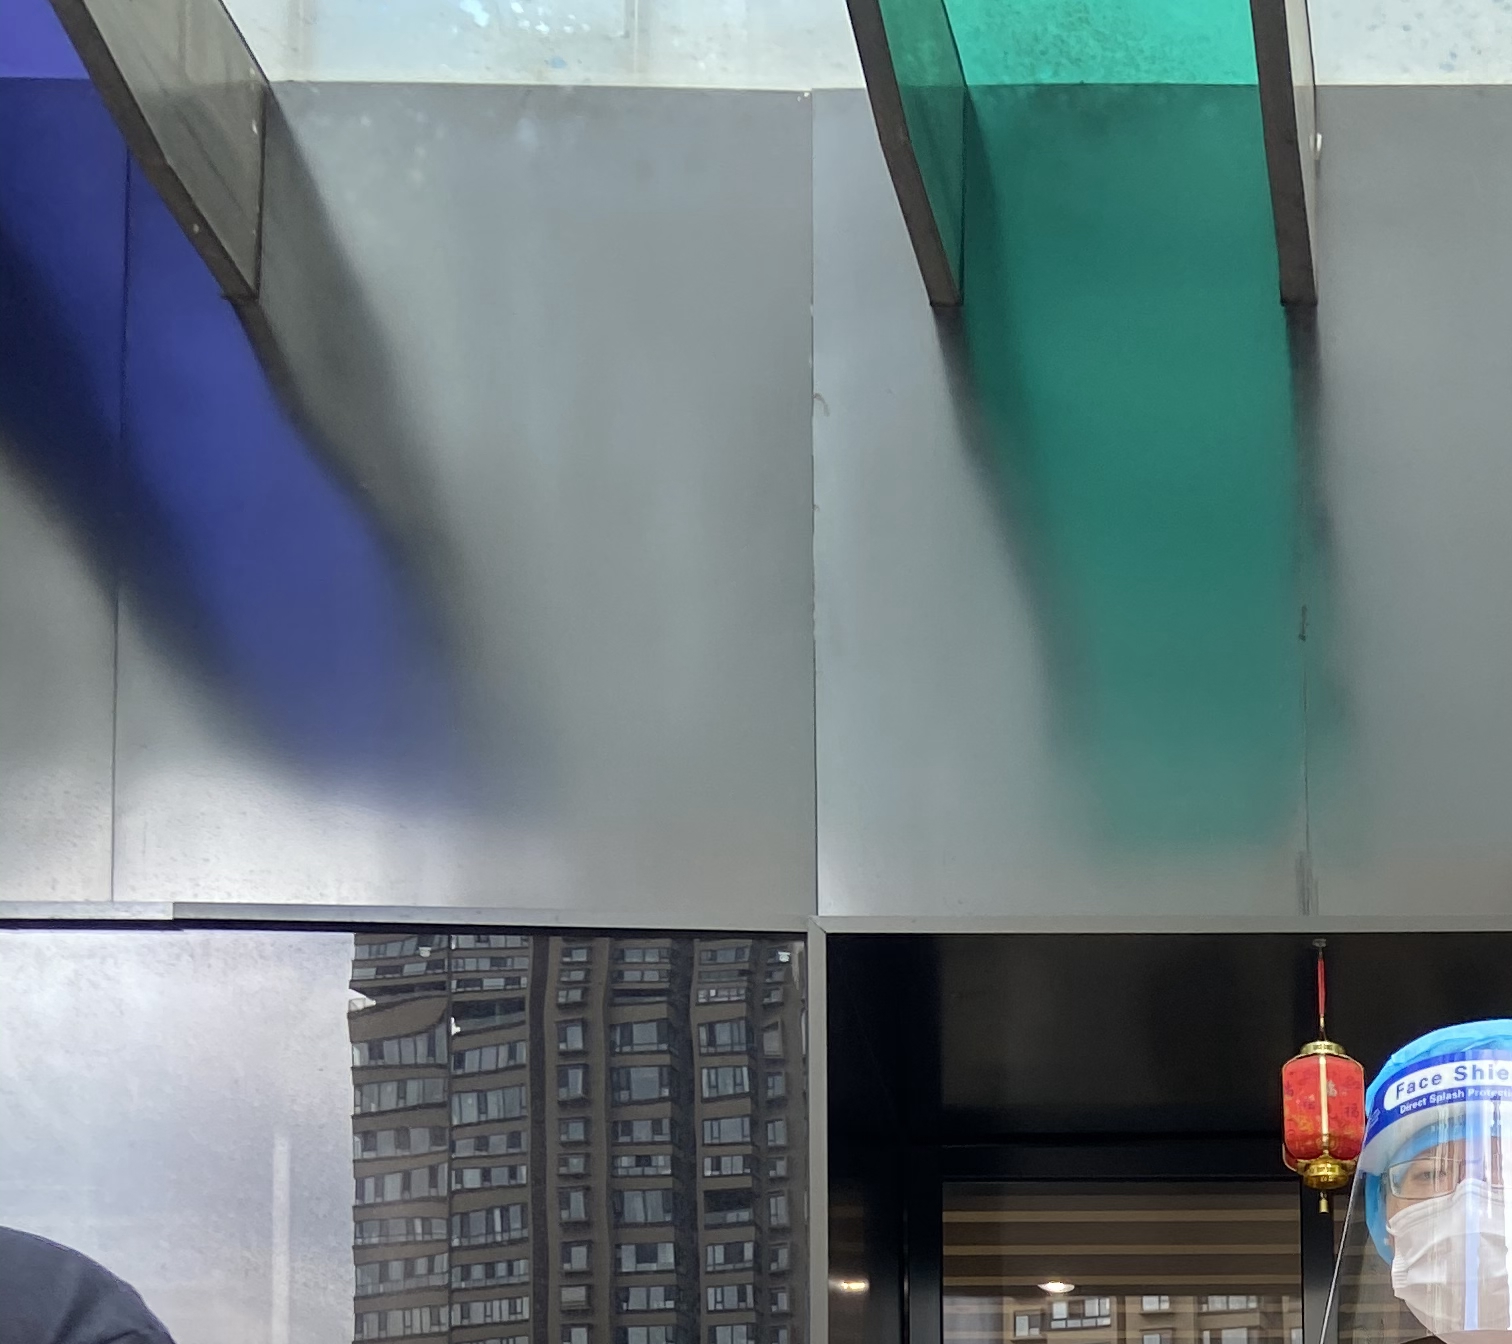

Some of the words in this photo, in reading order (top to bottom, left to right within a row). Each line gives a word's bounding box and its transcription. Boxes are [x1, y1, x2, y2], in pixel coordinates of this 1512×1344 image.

[1396, 1073, 1443, 1100] Face
[1400, 1098, 1427, 1114] Direct
[1430, 1090, 1464, 1104] Splash
